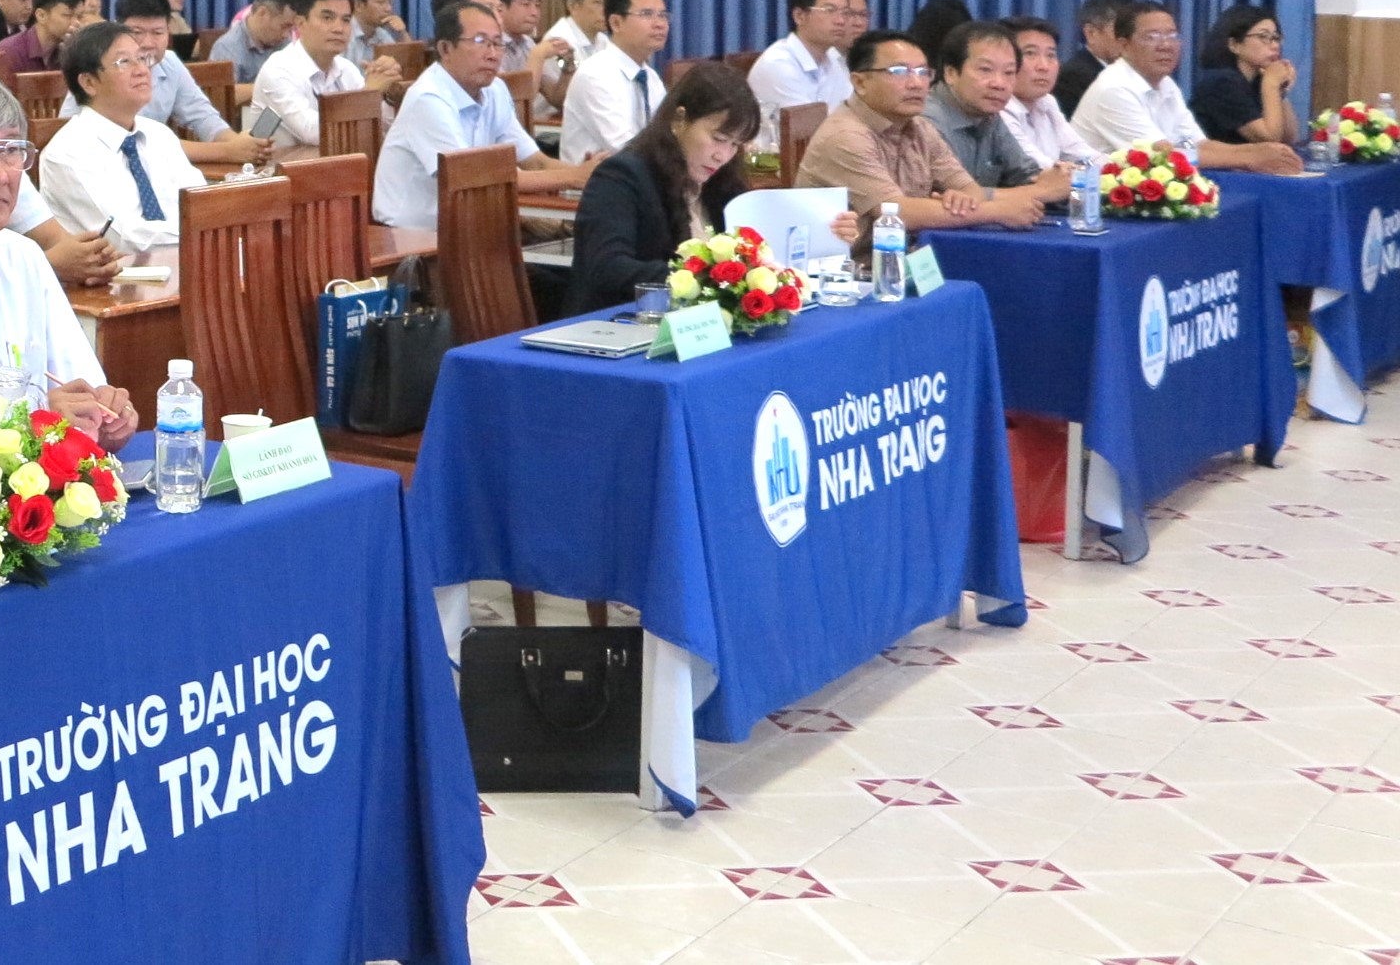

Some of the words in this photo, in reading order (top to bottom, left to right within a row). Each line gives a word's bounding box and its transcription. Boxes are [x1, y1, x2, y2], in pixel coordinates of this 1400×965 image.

[811, 391, 881, 446] TRƯỜNG
[818, 444, 875, 511] NHA
[179, 663, 245, 736] ĐẠI
[253, 633, 331, 707] HỌC
[5, 780, 147, 906] NHA
[159, 699, 337, 839] TRANG
